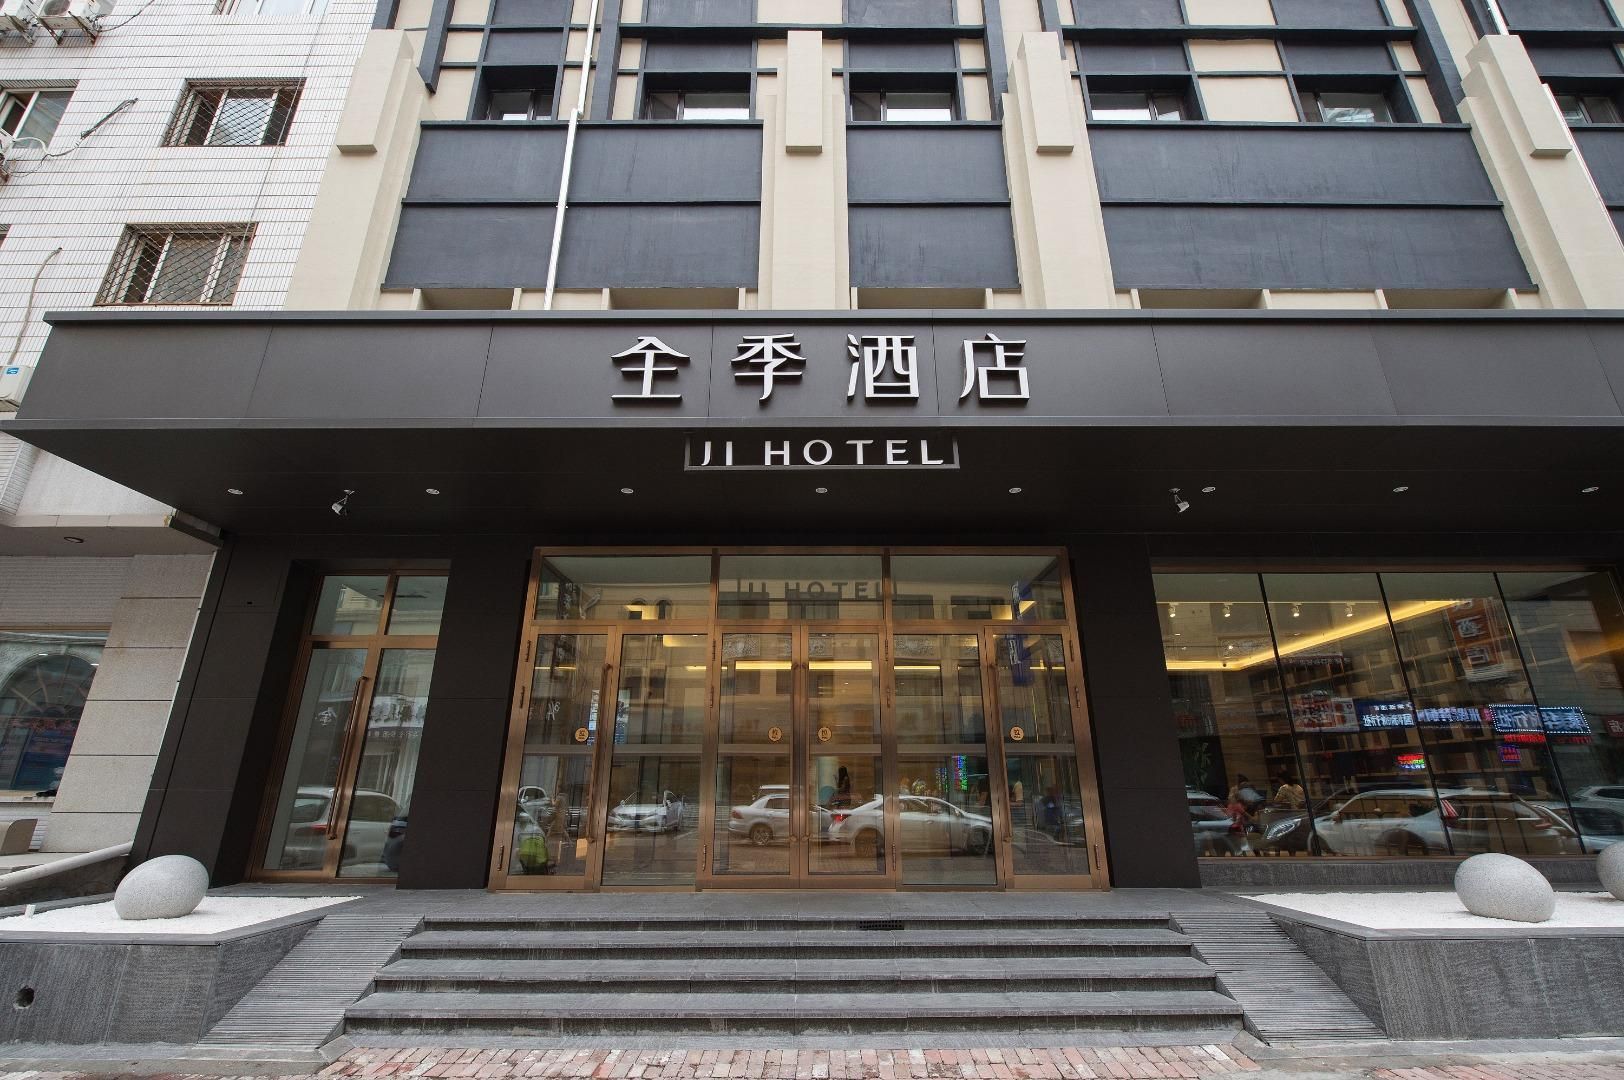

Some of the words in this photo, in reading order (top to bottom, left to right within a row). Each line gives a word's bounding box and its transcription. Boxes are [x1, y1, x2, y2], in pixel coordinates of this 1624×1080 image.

[611, 333, 1031, 405] 全季酒店
[700, 440, 734, 466] JI
[764, 439, 945, 466] HOTEL
